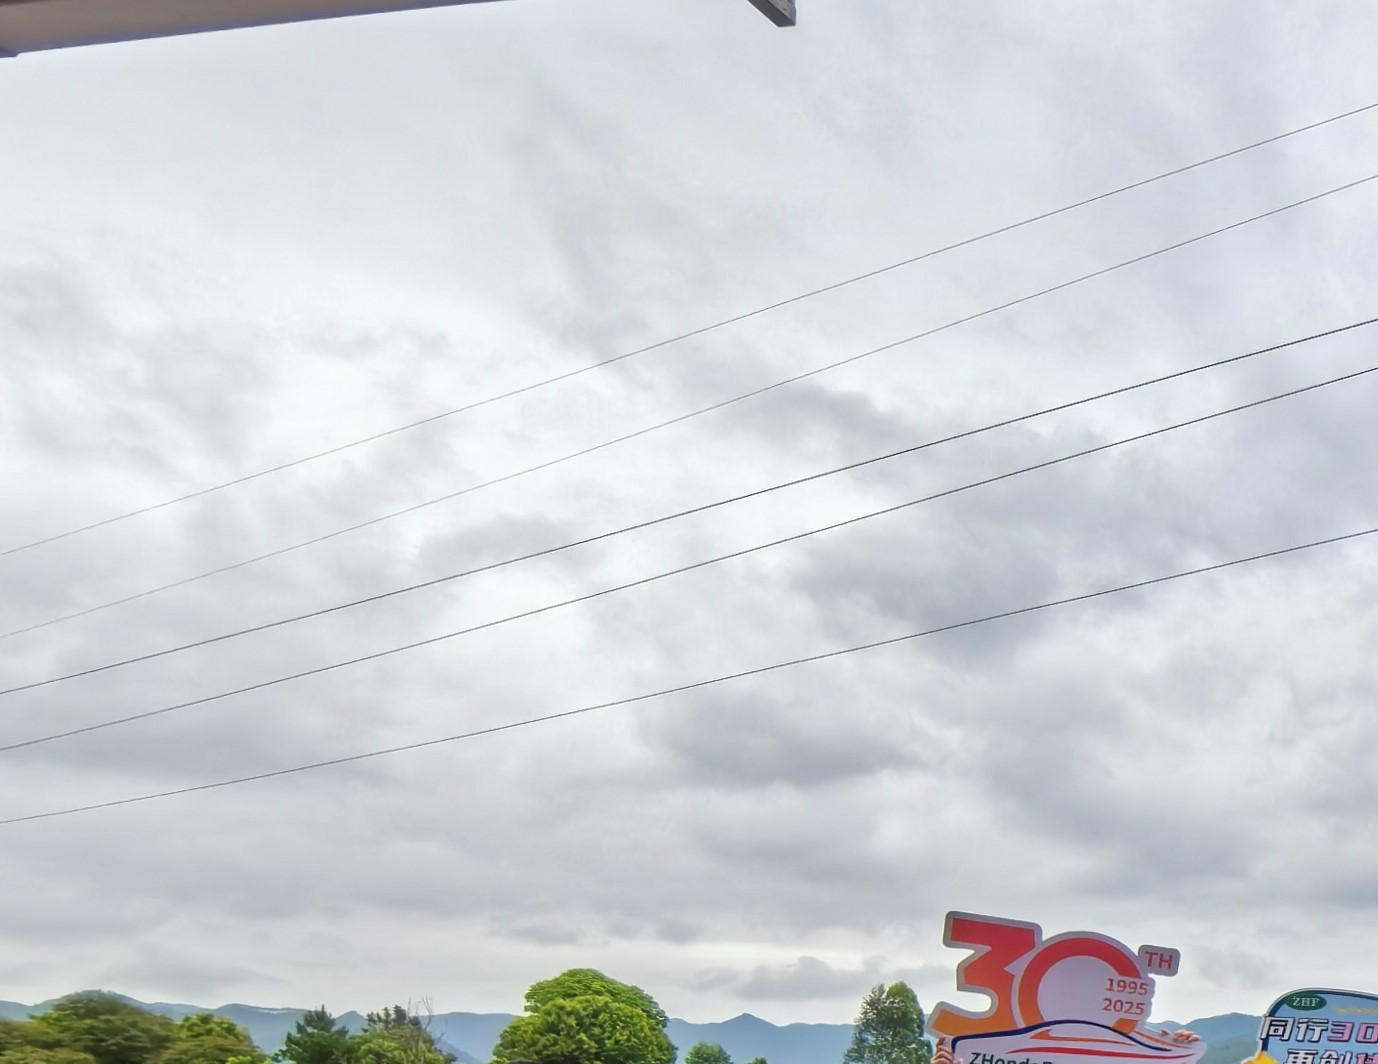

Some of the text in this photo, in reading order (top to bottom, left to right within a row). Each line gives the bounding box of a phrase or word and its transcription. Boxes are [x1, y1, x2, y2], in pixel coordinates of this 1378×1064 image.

[1145, 951, 1173, 969] TH
[1105, 978, 1149, 996] 1995
[1101, 998, 1145, 1016] 2025
[1292, 996, 1321, 1007] ZHF
